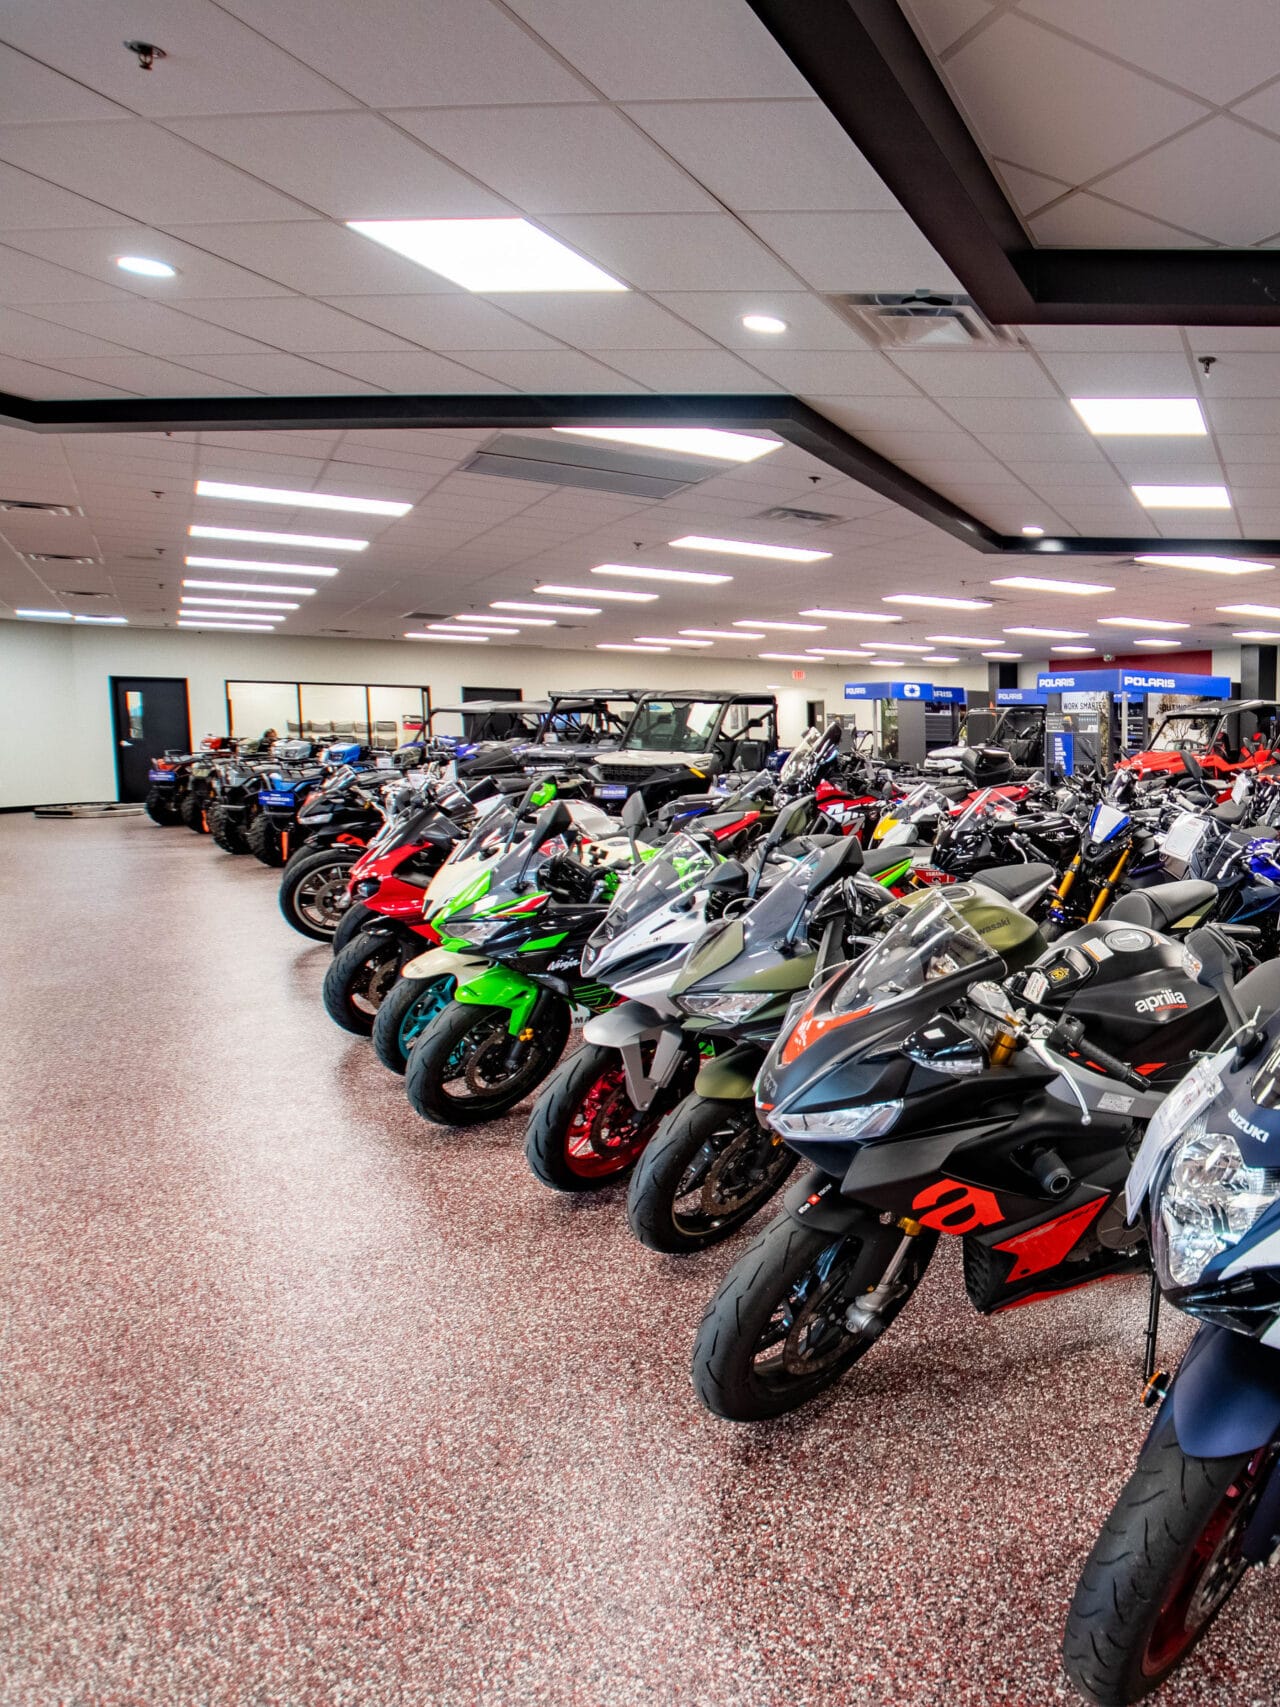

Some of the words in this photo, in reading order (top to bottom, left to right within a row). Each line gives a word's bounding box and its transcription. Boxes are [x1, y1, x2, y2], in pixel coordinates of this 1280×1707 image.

[1039, 677, 1075, 688] POLARIS
[1124, 676, 1176, 688] POLARIS
[1063, 702, 1079, 710] WORK
[547, 958, 581, 971] Ninja
[1135, 989, 1187, 1013] aprilia
[1228, 1108, 1270, 1143] SUZUKI
